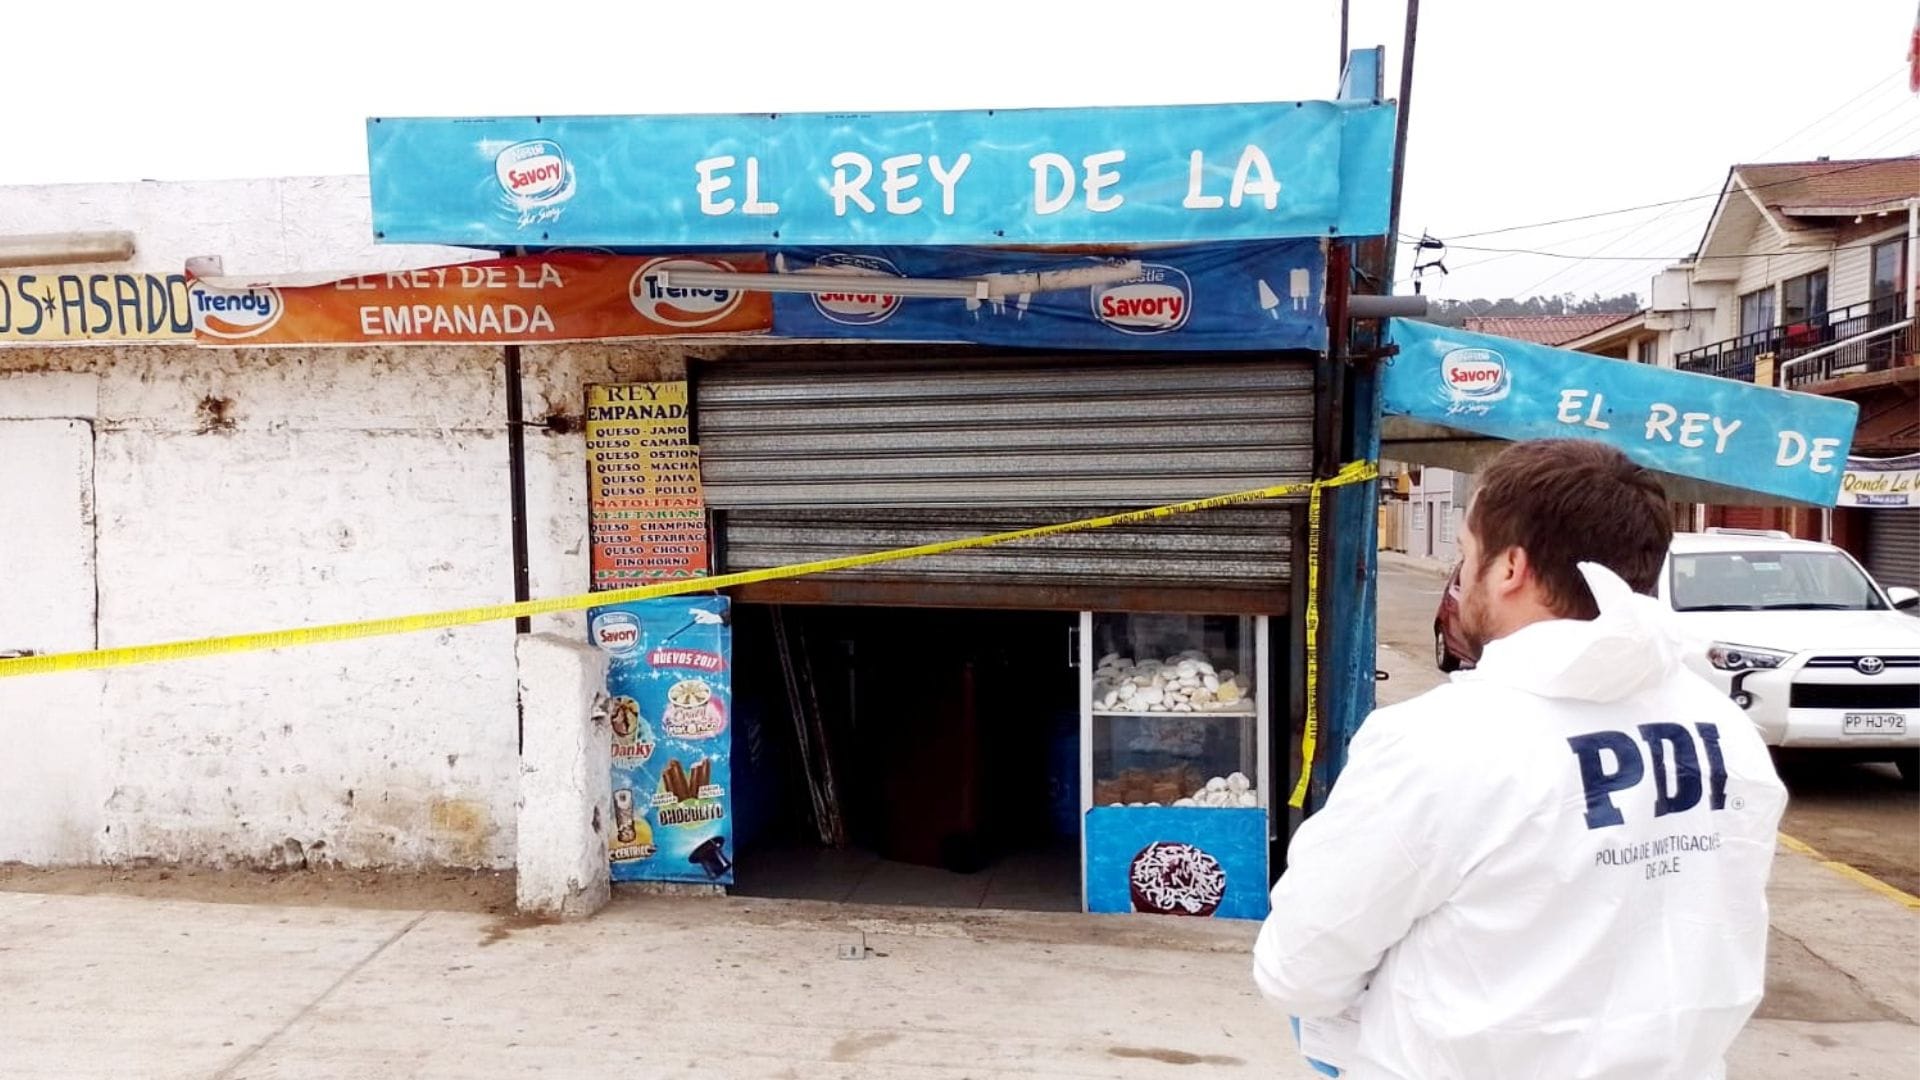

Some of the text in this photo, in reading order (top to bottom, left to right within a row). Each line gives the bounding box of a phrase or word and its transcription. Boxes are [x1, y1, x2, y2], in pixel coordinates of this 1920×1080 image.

[507, 162, 560, 189] Savory
[695, 143, 1281, 217] EL REY DE LA
[386, 268, 449, 289] REY
[457, 266, 507, 288] DE
[513, 262, 564, 288] LA
[192, 289, 271, 315] Trendy
[1102, 295, 1182, 320] Savory
[359, 303, 556, 335] EMPANADA
[1450, 366, 1499, 383] Savory
[607, 384, 661, 401] REY
[587, 404, 688, 421] EMPANADA
[596, 426, 687, 438] QUESO JAMO
[1557, 388, 1840, 474] EL REY DE
[586, 438, 688, 450] QUESO CAMAR
[595, 450, 698, 461] QUESO OSTION
[597, 461, 698, 473] QUESO MACHA
[602, 474, 695, 485] QUESO JAIVA
[1844, 473, 1888, 491] Donde
[1890, 473, 1909, 492] La
[601, 486, 697, 497] QUESO POLLO
[605, 546, 699, 556] QUESO CHOCLO
[646, 557, 690, 565] HORNO
[600, 629, 637, 642] Savory
[653, 653, 718, 667] NUEVOS 2017
[1846, 716, 1861, 728] PP
[611, 742, 653, 758] Danky
[1566, 722, 1728, 830] PDI
